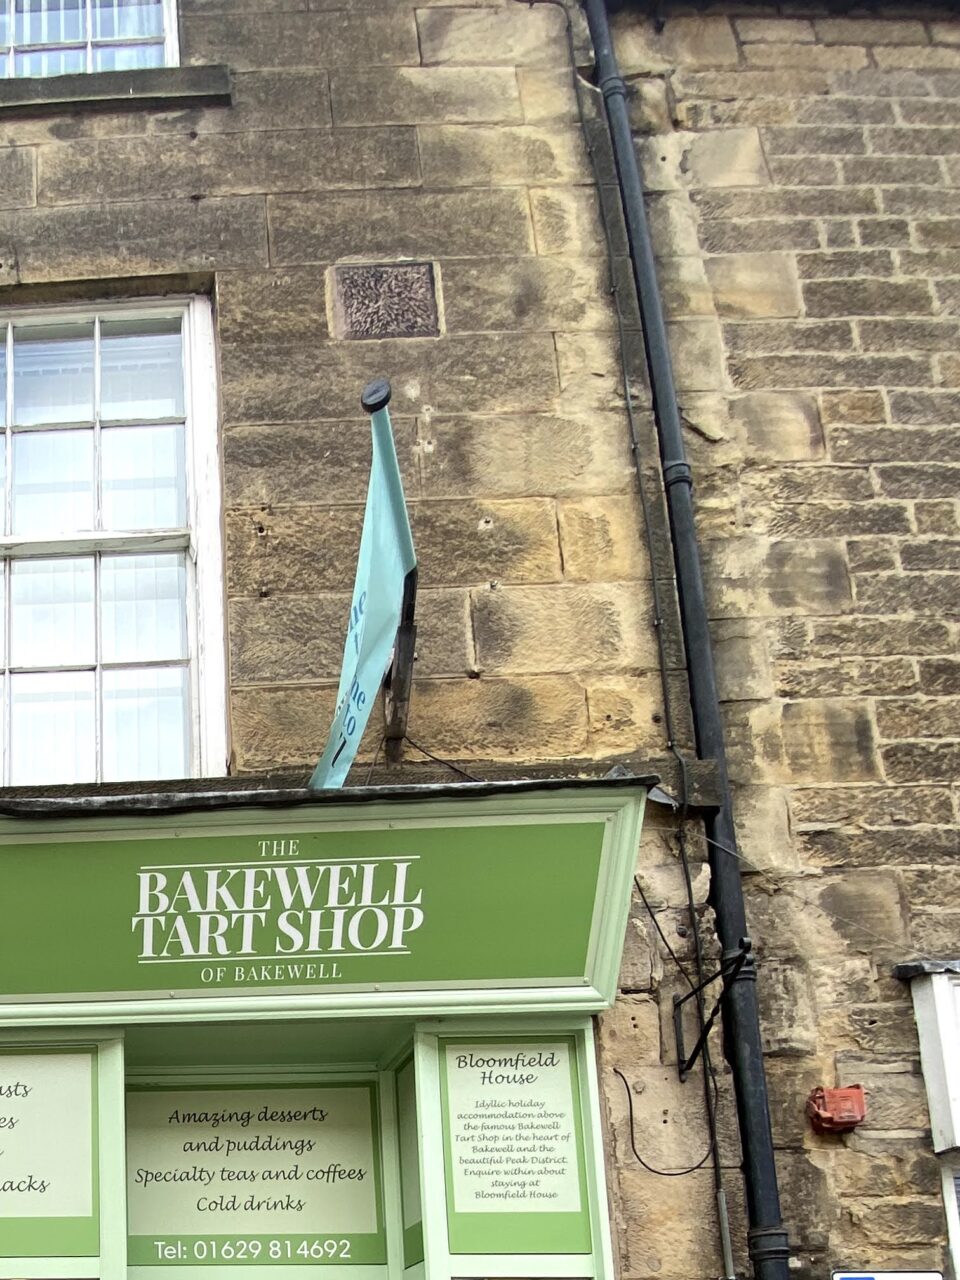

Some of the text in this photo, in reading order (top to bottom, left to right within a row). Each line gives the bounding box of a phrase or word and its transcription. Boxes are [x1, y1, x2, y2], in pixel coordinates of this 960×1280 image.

[258, 840, 300, 856] THE
[136, 862, 422, 915] BAKEWELL
[132, 907, 424, 957] TART SHOP
[201, 964, 342, 983] OF BAKEWELL
[456, 1053, 560, 1070] Bloomfield
[480, 1070, 538, 1085] House
[475, 1099, 545, 1109] Idyllic holiday
[168, 1106, 329, 1128] Amazing desserts
[457, 1110, 566, 1119] accommodation above
[464, 1121, 561, 1131] the famous Bakewell
[455, 1134, 475, 1142] Tart
[477, 1133, 500, 1143] Shop
[515, 1133, 531, 1141] the
[532, 1133, 559, 1141] heart
[560, 1132, 571, 1142] of
[183, 1135, 316, 1156] and puddings
[472, 1144, 556, 1153] Bakewell and the
[459, 1156, 503, 1165] beautiful
[506, 1156, 528, 1164] Peak
[135, 1164, 367, 1187] Specialty teas and coffees
[464, 1167, 567, 1177] Enquire within about
[491, 1179, 540, 1188] staying at
[475, 1190, 558, 1200] Bloomfield House
[196, 1194, 306, 1212] Cold drinks
[154, 1239, 351, 1259] Tel: 01629 814692
